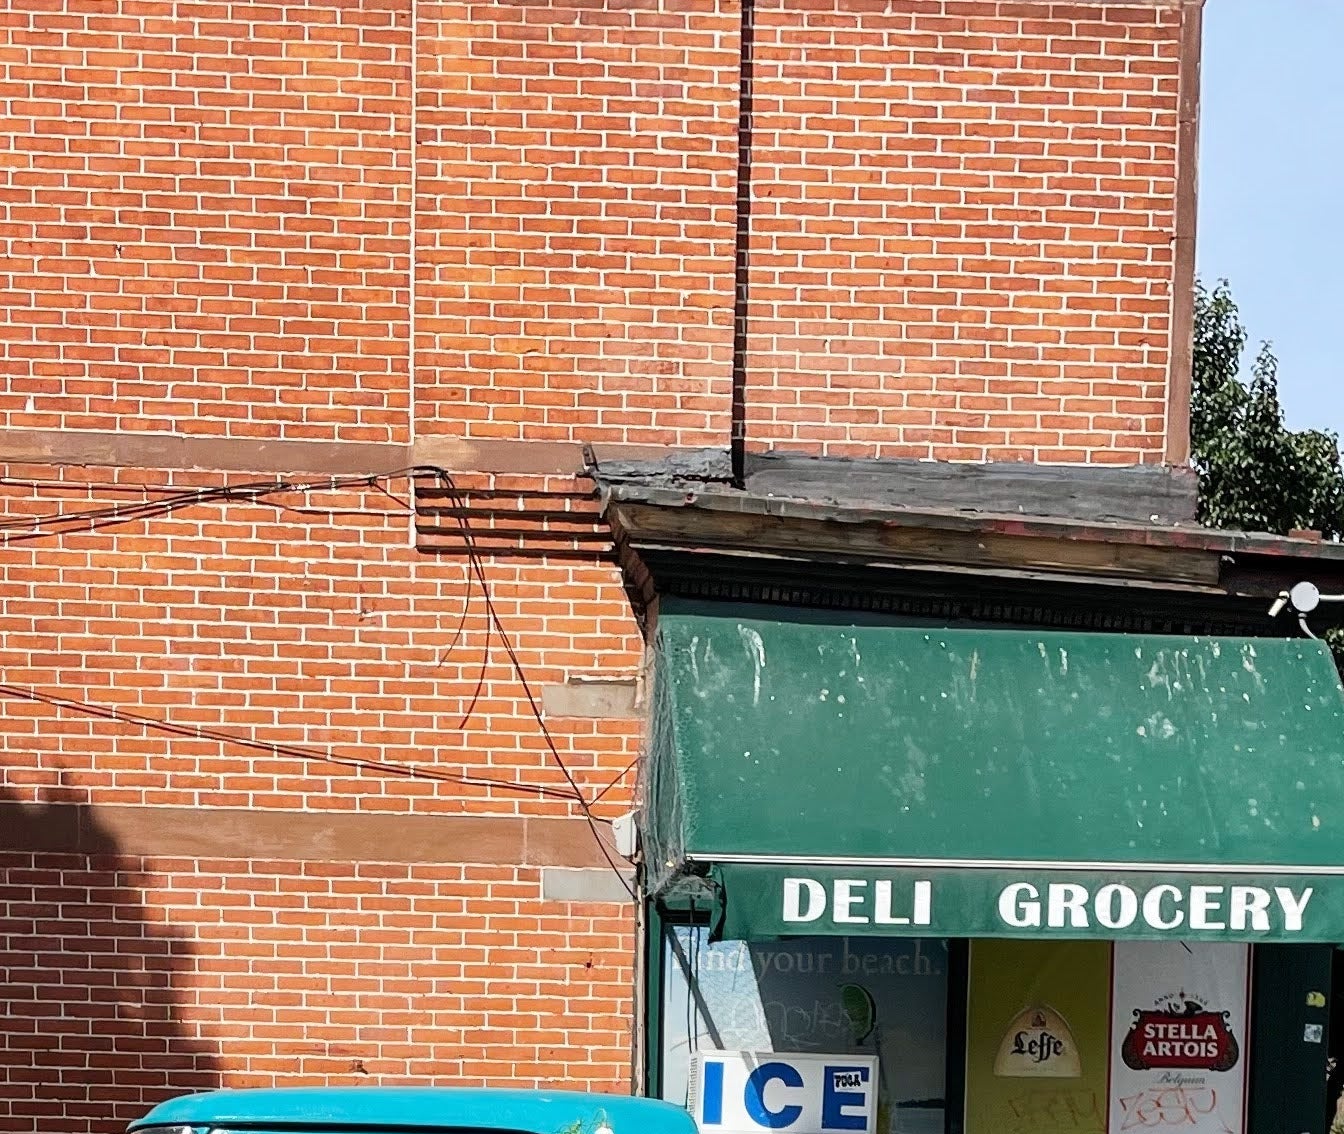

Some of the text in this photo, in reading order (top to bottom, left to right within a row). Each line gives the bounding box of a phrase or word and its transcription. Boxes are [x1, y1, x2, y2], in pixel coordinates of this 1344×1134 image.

[782, 877, 1314, 932] DELI GROCERY
[756, 951, 833, 983] your
[1010, 1030, 1064, 1064] Leffe
[1143, 1023, 1218, 1040] STELLA
[1142, 1041, 1219, 1058] ARTOIS
[1158, 1071, 1205, 1087] Belgium
[702, 1061, 870, 1131] ICE
